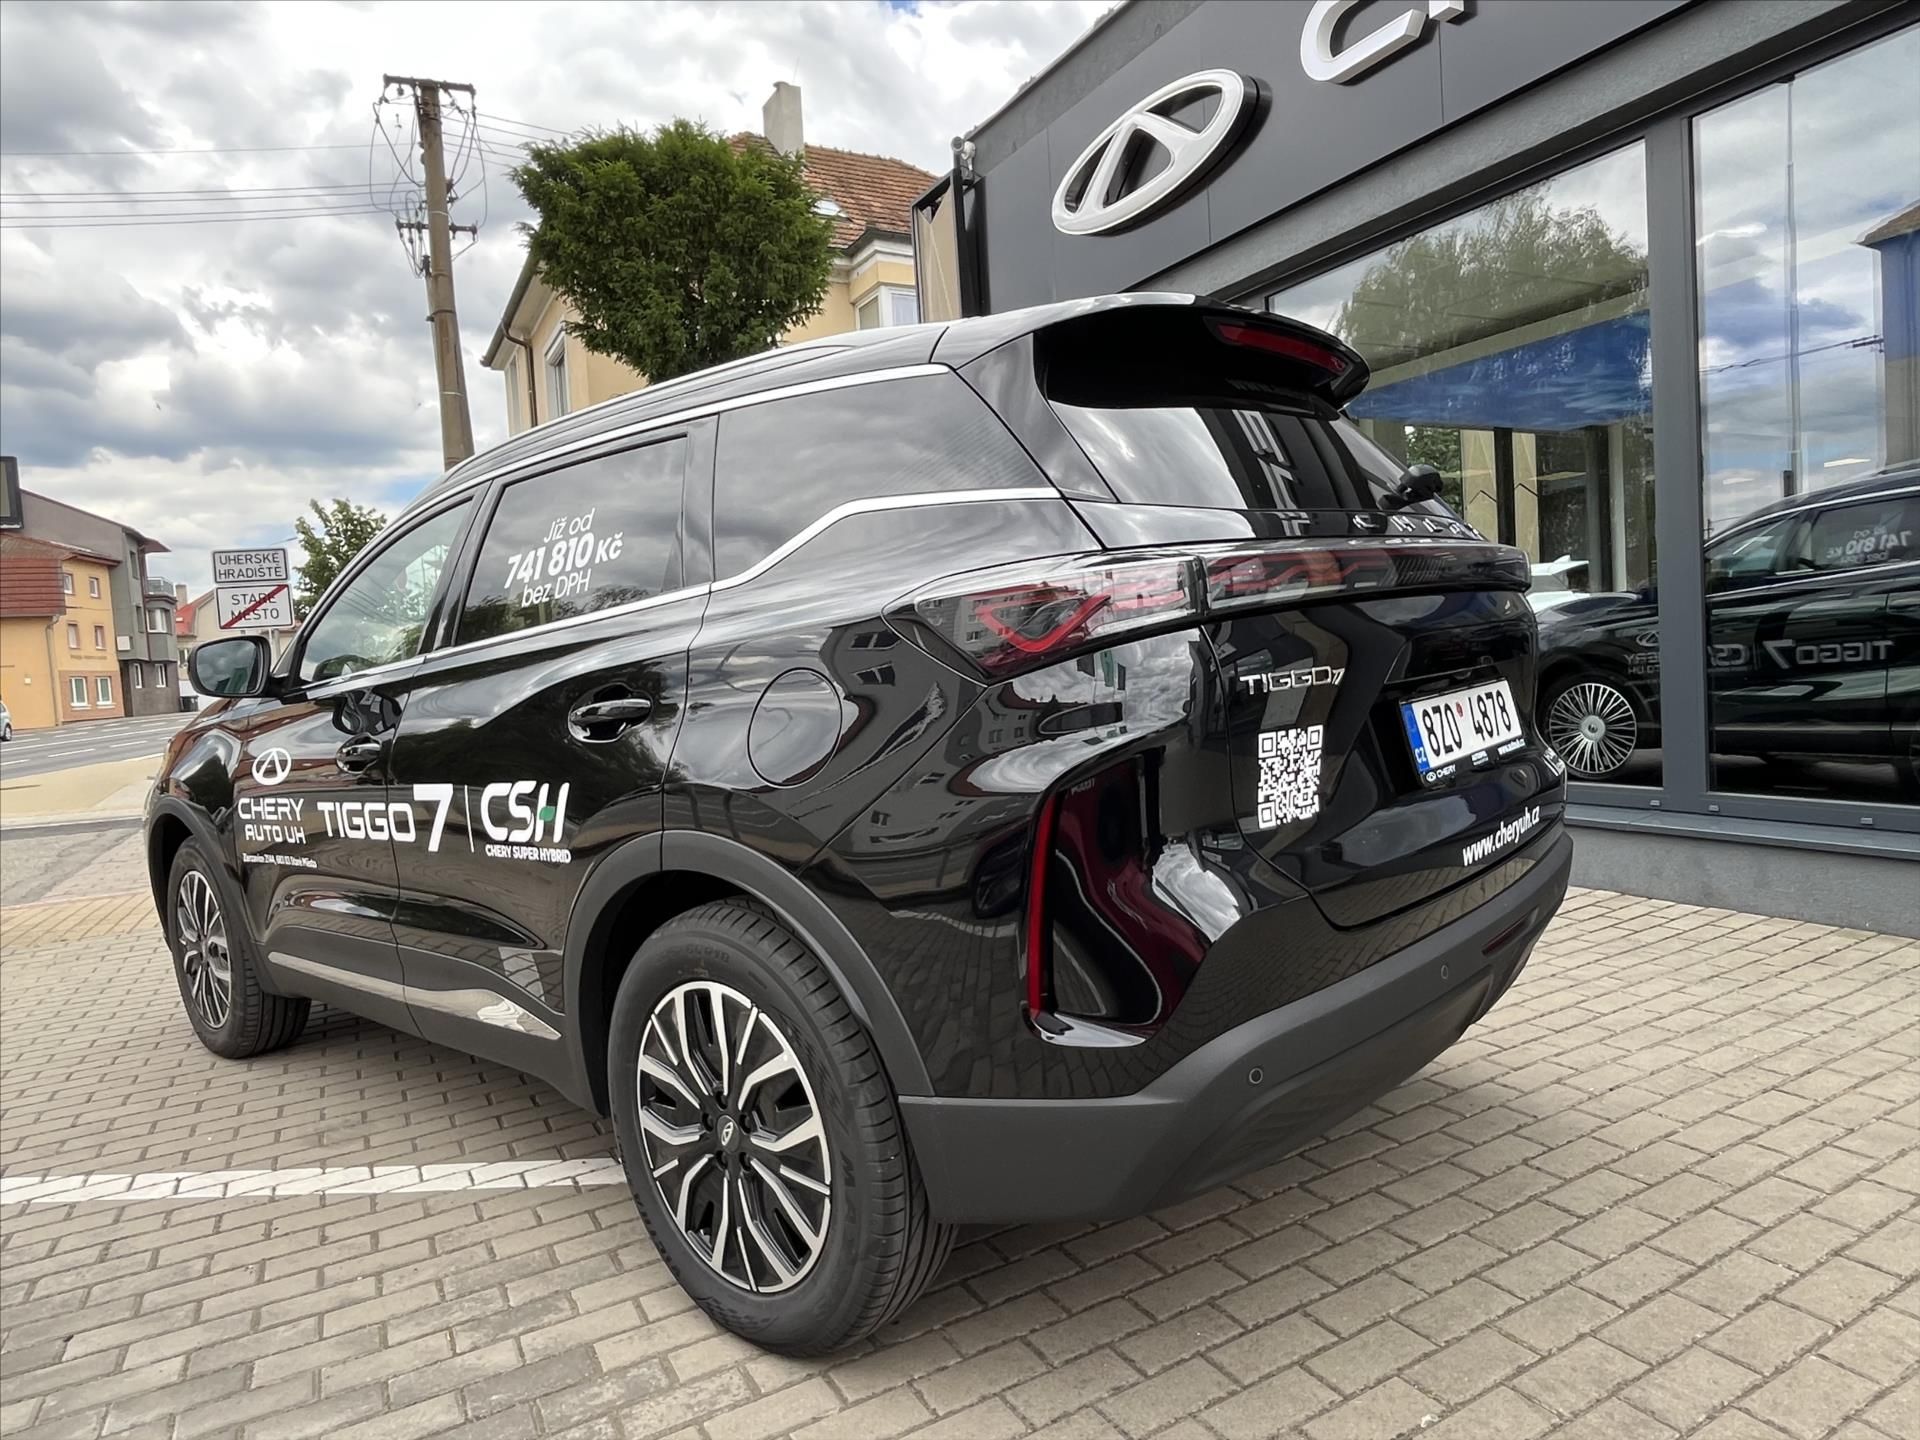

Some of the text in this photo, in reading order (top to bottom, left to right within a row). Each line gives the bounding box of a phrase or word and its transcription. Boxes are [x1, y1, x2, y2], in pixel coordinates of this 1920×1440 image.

[543, 507, 595, 543] Již od
[218, 564, 283, 579] HRADIŠTĚ
[504, 532, 623, 589] 741 810 Kč
[521, 568, 591, 608] bez DPH
[1467, 689, 1512, 742] 4878
[1414, 747, 1427, 763] CZ
[237, 797, 305, 822] CHERY
[316, 783, 453, 852] TIGGO 7
[480, 780, 570, 843] CSH
[244, 823, 306, 844] AUTO UH
[485, 844, 572, 864] CHERY SUPER HYBRID
